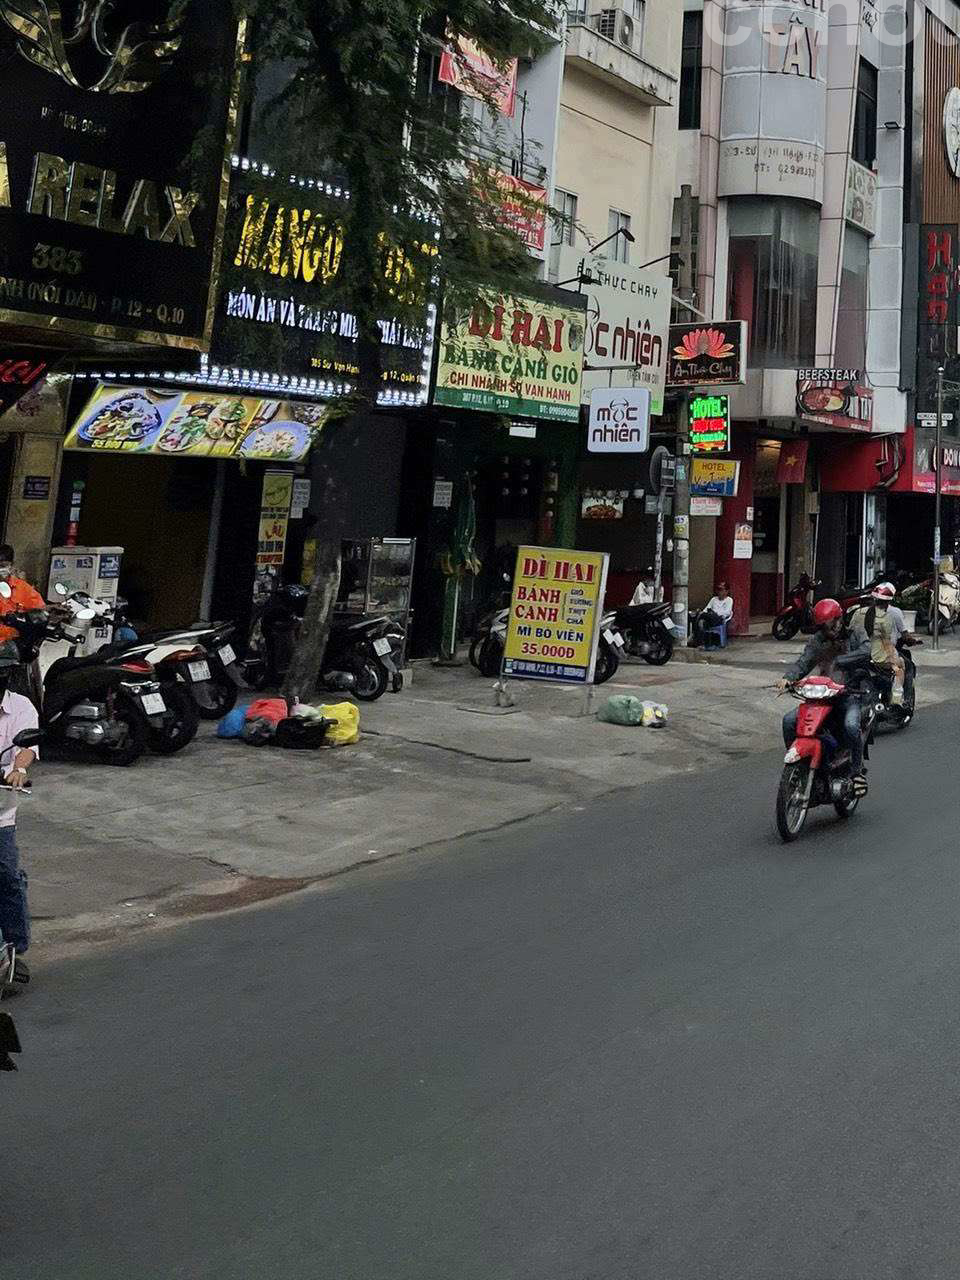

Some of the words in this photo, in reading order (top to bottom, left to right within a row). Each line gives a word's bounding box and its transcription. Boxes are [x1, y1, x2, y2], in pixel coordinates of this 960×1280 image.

[763, 12, 821, 81] TÂY
[26, 151, 201, 249] RELAX
[631, 281, 658, 299] CHAY
[227, 286, 256, 320] MÓN
[279, 296, 297, 328] VÀ
[511, 309, 565, 354] HAI
[612, 317, 662, 368] nhiên
[450, 371, 468, 386] CHI
[501, 354, 549, 381] CANH
[551, 362, 579, 386] GIÒ
[798, 368, 858, 382] BEEFSTEAK
[693, 399, 722, 418] HOTEL
[592, 423, 641, 442] nhiên
[702, 462, 726, 472] HOTEL
[522, 555, 548, 580] DÌ
[553, 561, 596, 582] HAI
[516, 584, 561, 604] BÁNH
[514, 605, 559, 623] CANH
